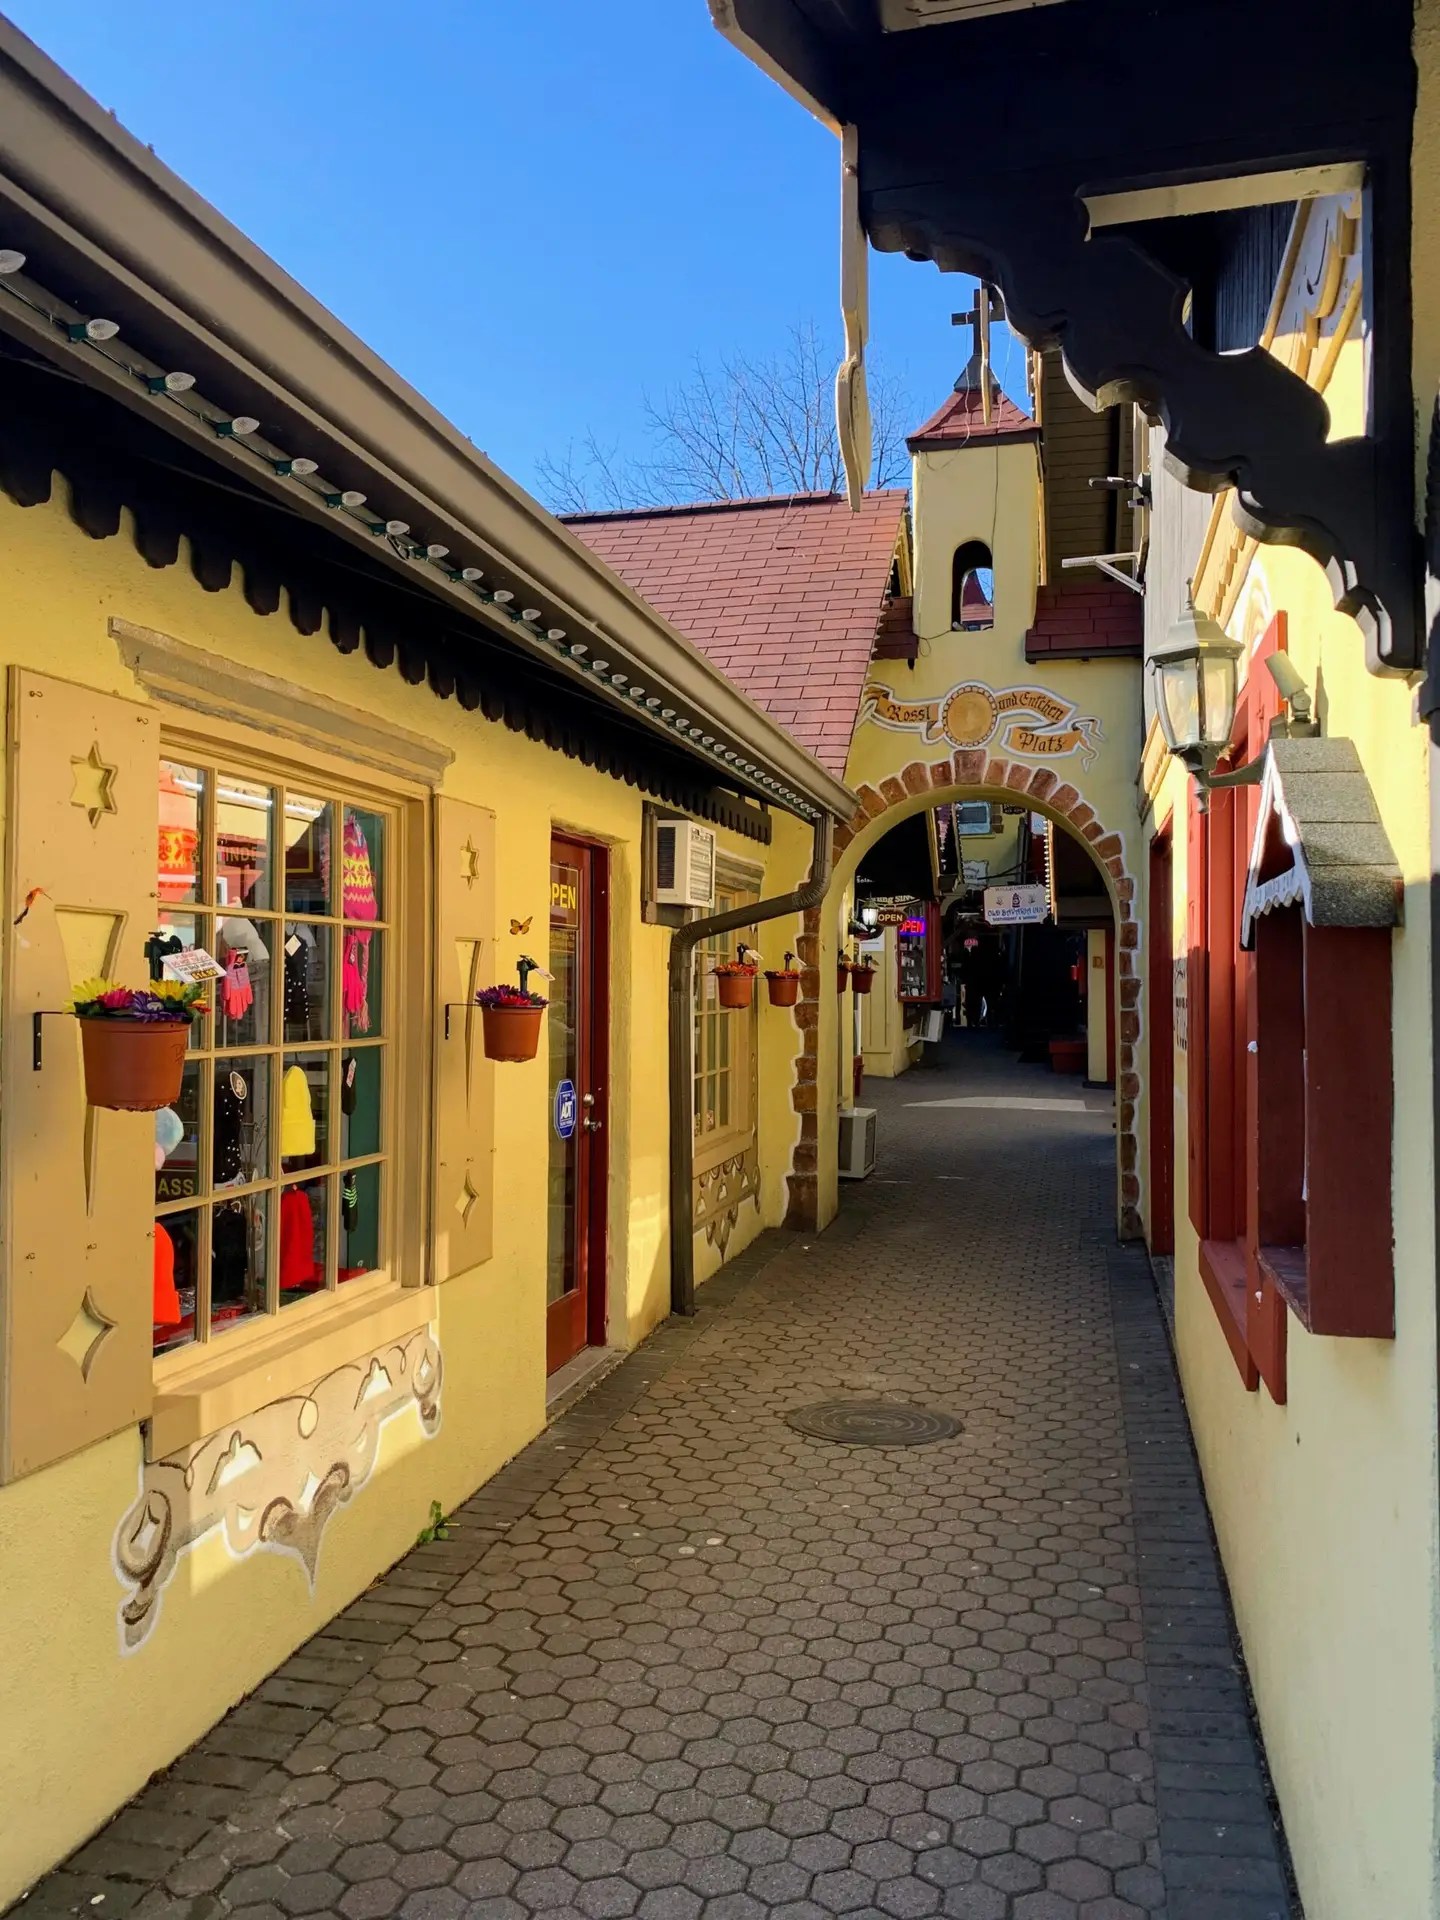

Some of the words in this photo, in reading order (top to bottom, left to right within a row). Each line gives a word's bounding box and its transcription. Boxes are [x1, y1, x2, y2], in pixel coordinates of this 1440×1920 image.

[998, 692, 1017, 710] und
[1019, 731, 1065, 751] Platz
[550, 881, 576, 909] PEN
[878, 913, 903, 922] OPEN
[561, 1100, 573, 1119] ADT
